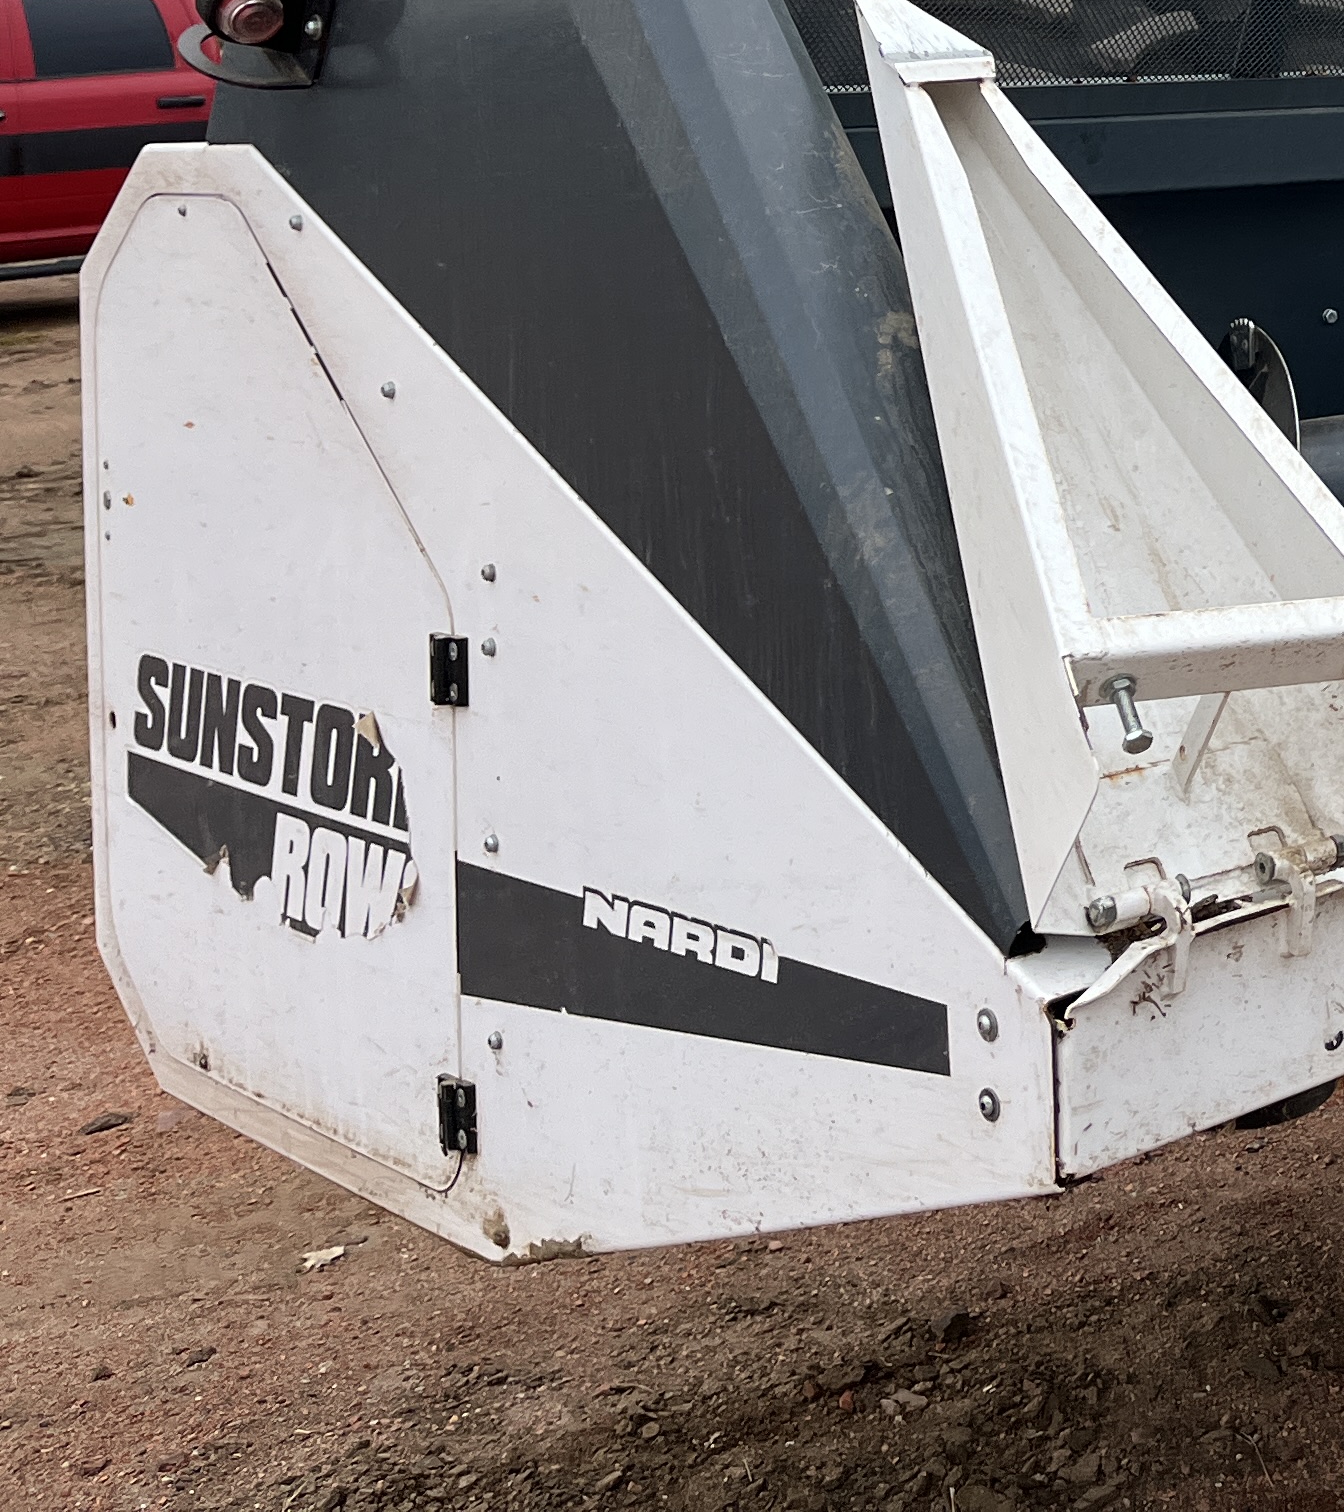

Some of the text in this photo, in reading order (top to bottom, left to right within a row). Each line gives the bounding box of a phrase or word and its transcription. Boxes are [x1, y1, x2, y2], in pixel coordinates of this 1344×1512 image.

[134, 654, 410, 832] SUNSTOR
[271, 811, 419, 940] ROW
[582, 885, 779, 985] NARDI
